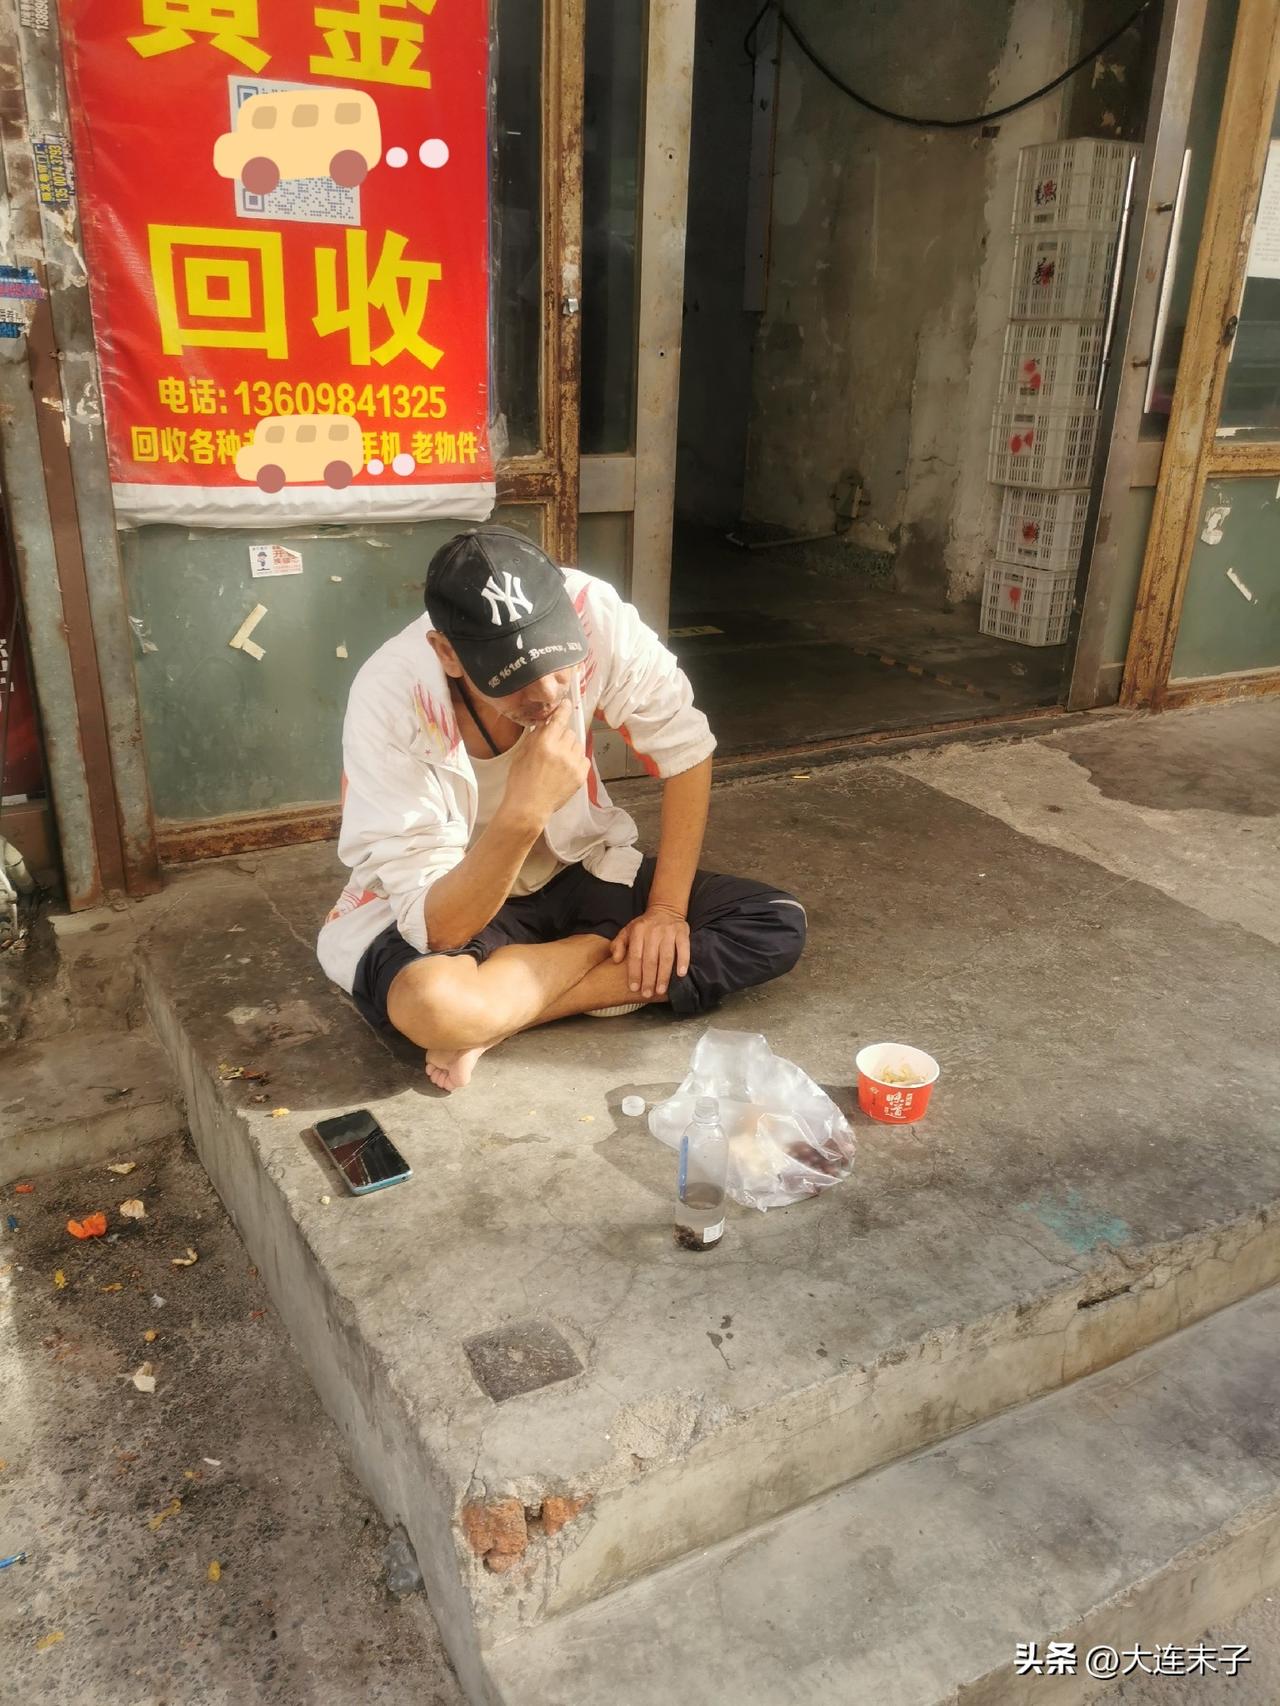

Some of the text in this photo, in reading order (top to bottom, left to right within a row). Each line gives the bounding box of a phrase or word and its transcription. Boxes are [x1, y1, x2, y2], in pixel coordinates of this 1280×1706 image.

[148, 224, 444, 369] 回收
[131, 426, 255, 465] 回收各种
[410, 431, 478, 464] 老物件
[481, 571, 534, 626] NY
